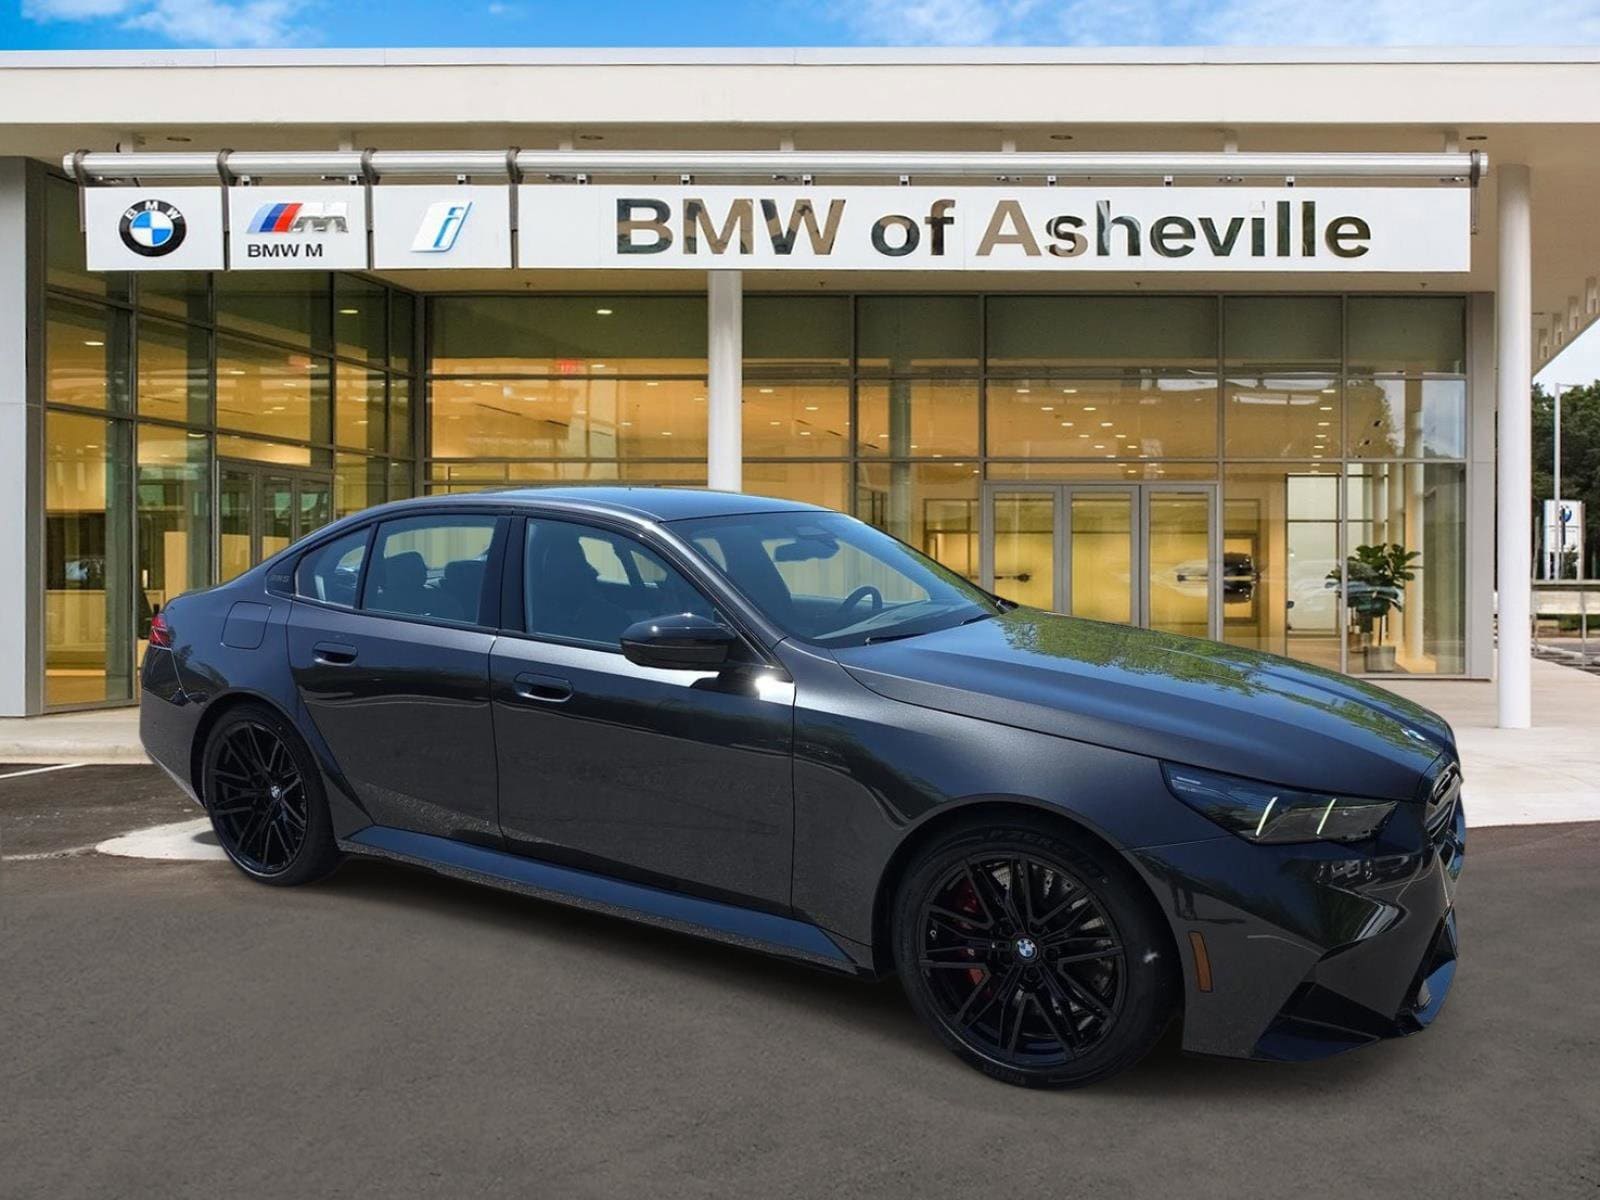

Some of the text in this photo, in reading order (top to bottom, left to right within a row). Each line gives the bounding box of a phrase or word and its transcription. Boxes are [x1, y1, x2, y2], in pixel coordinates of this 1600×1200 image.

[125, 200, 181, 220] BMW
[616, 198, 1372, 258] BMW of Asheville
[247, 243, 323, 258] BMW M
